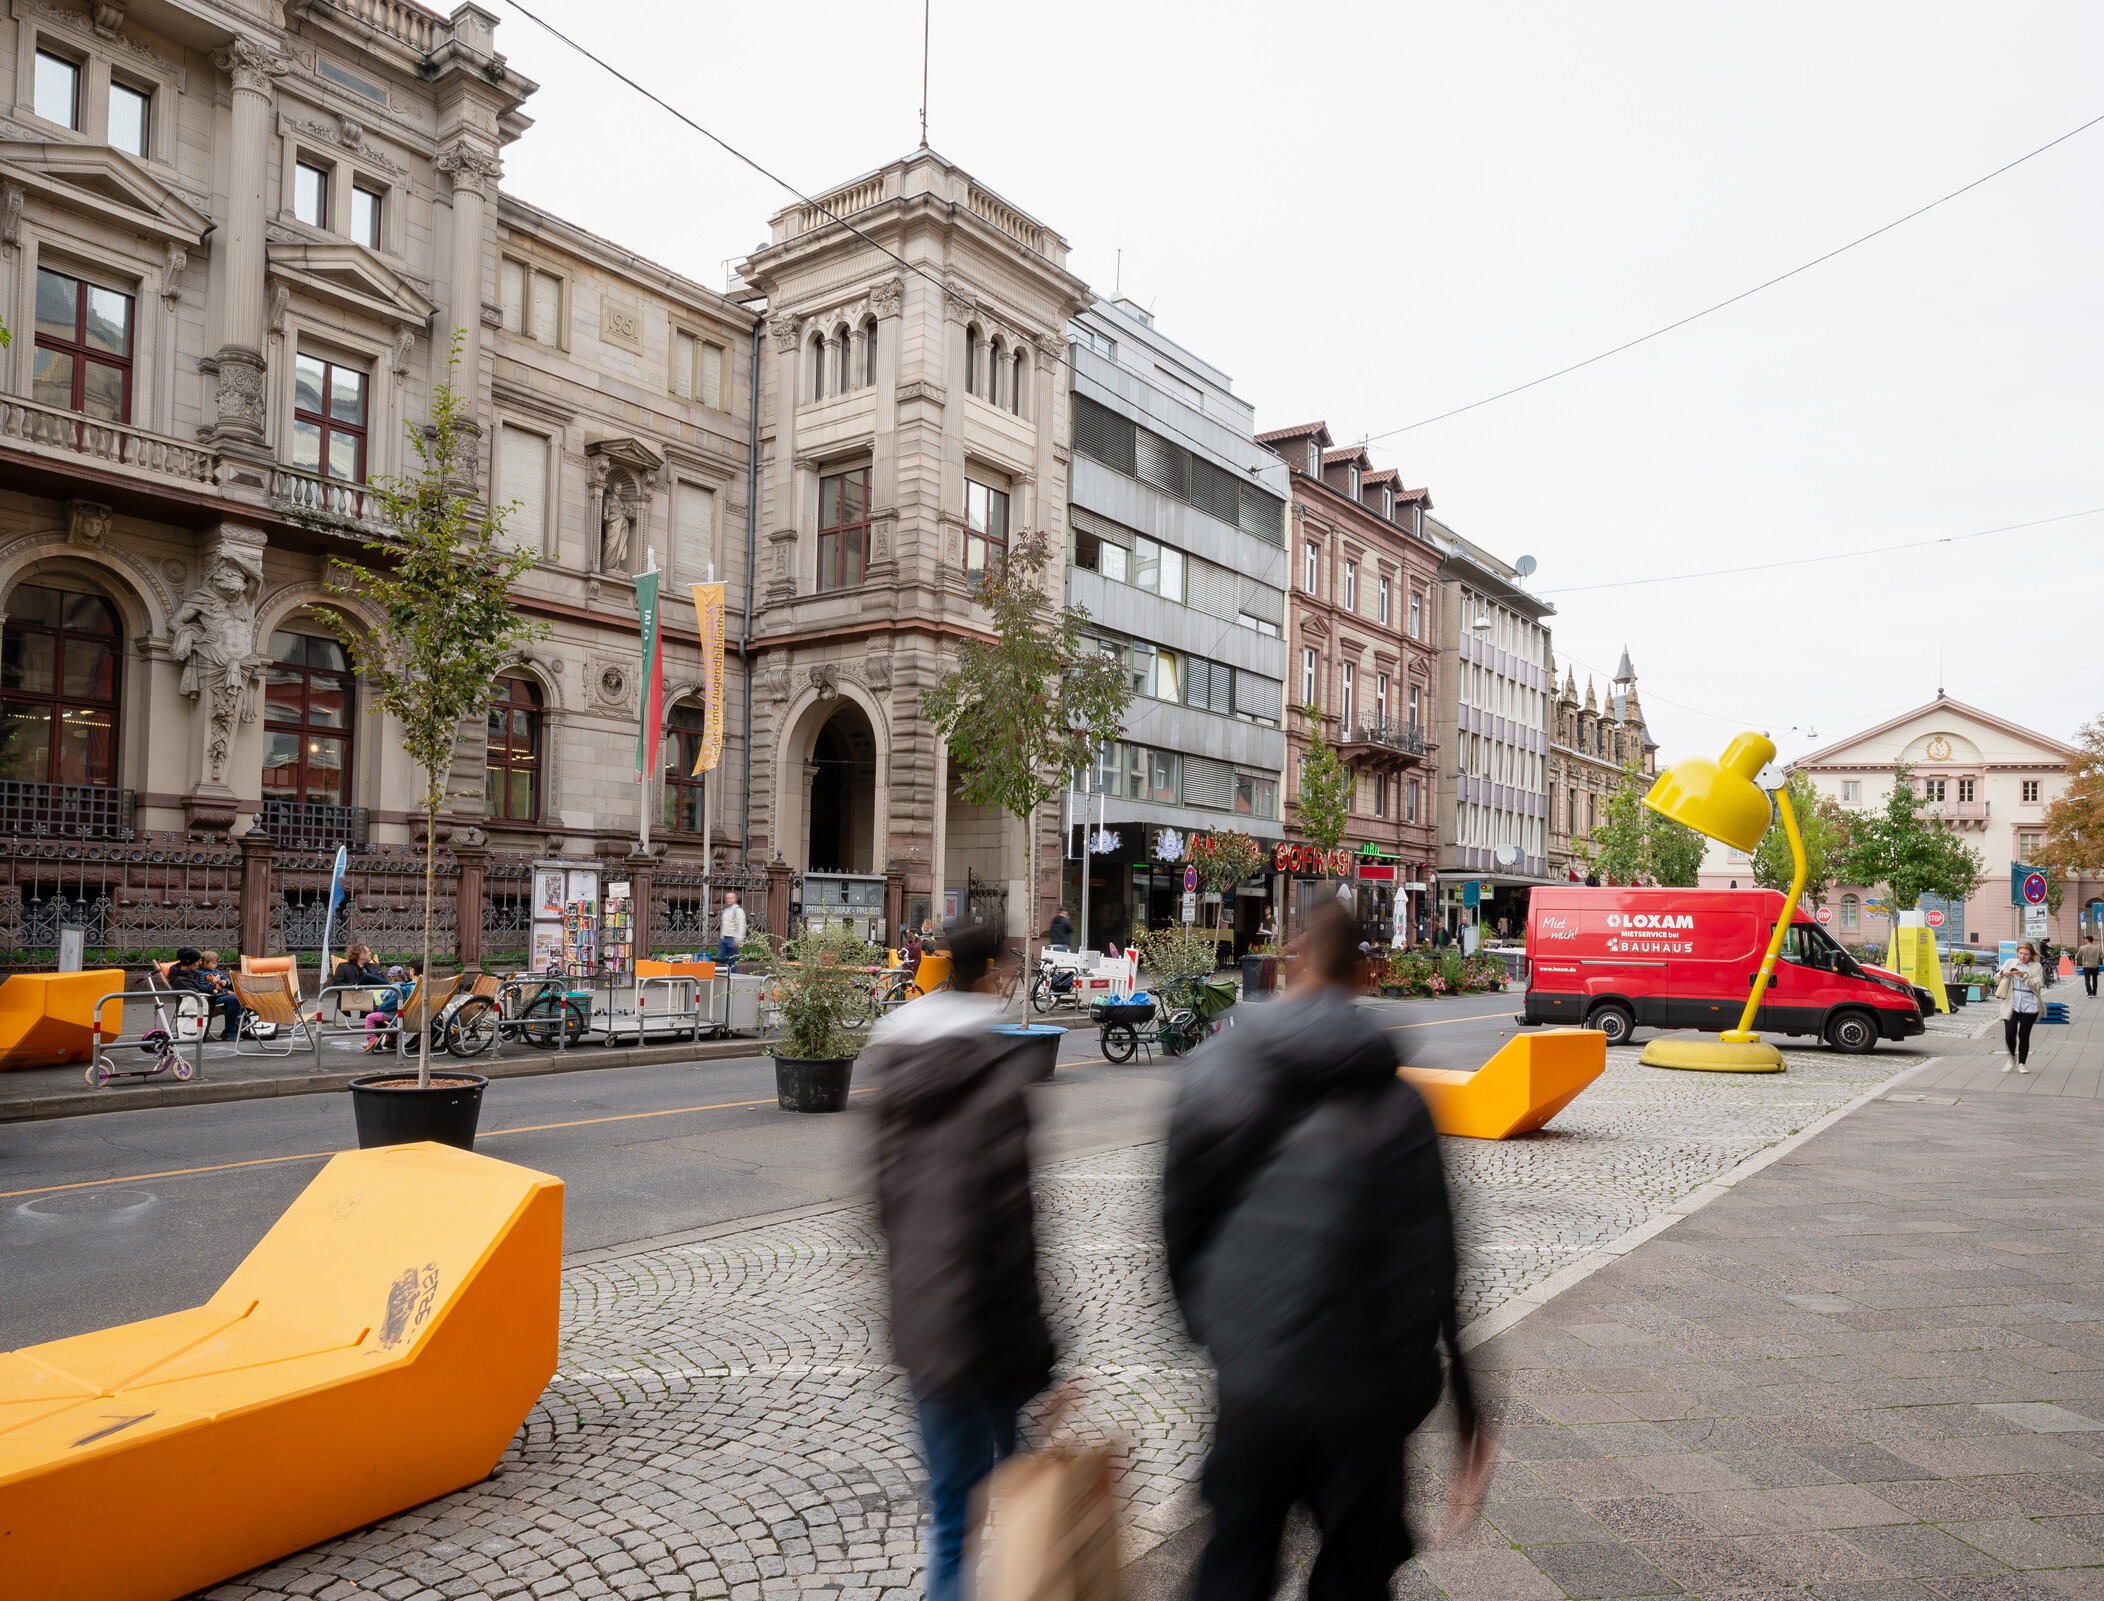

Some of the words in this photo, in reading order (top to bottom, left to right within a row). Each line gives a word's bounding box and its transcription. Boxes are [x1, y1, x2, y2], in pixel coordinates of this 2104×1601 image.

[712, 603, 724, 701] Jugendbibliothek
[712, 704, 720, 725] und
[1275, 842, 1353, 876] SOFRASI
[834, 906, 851, 914] MAX
[857, 906, 881, 915] PALAIS
[1542, 916, 1567, 929] Miet
[1623, 915, 1694, 929] LOXAM
[1551, 928, 1578, 940] mich!
[1621, 942, 1692, 952] BAUHAUS
